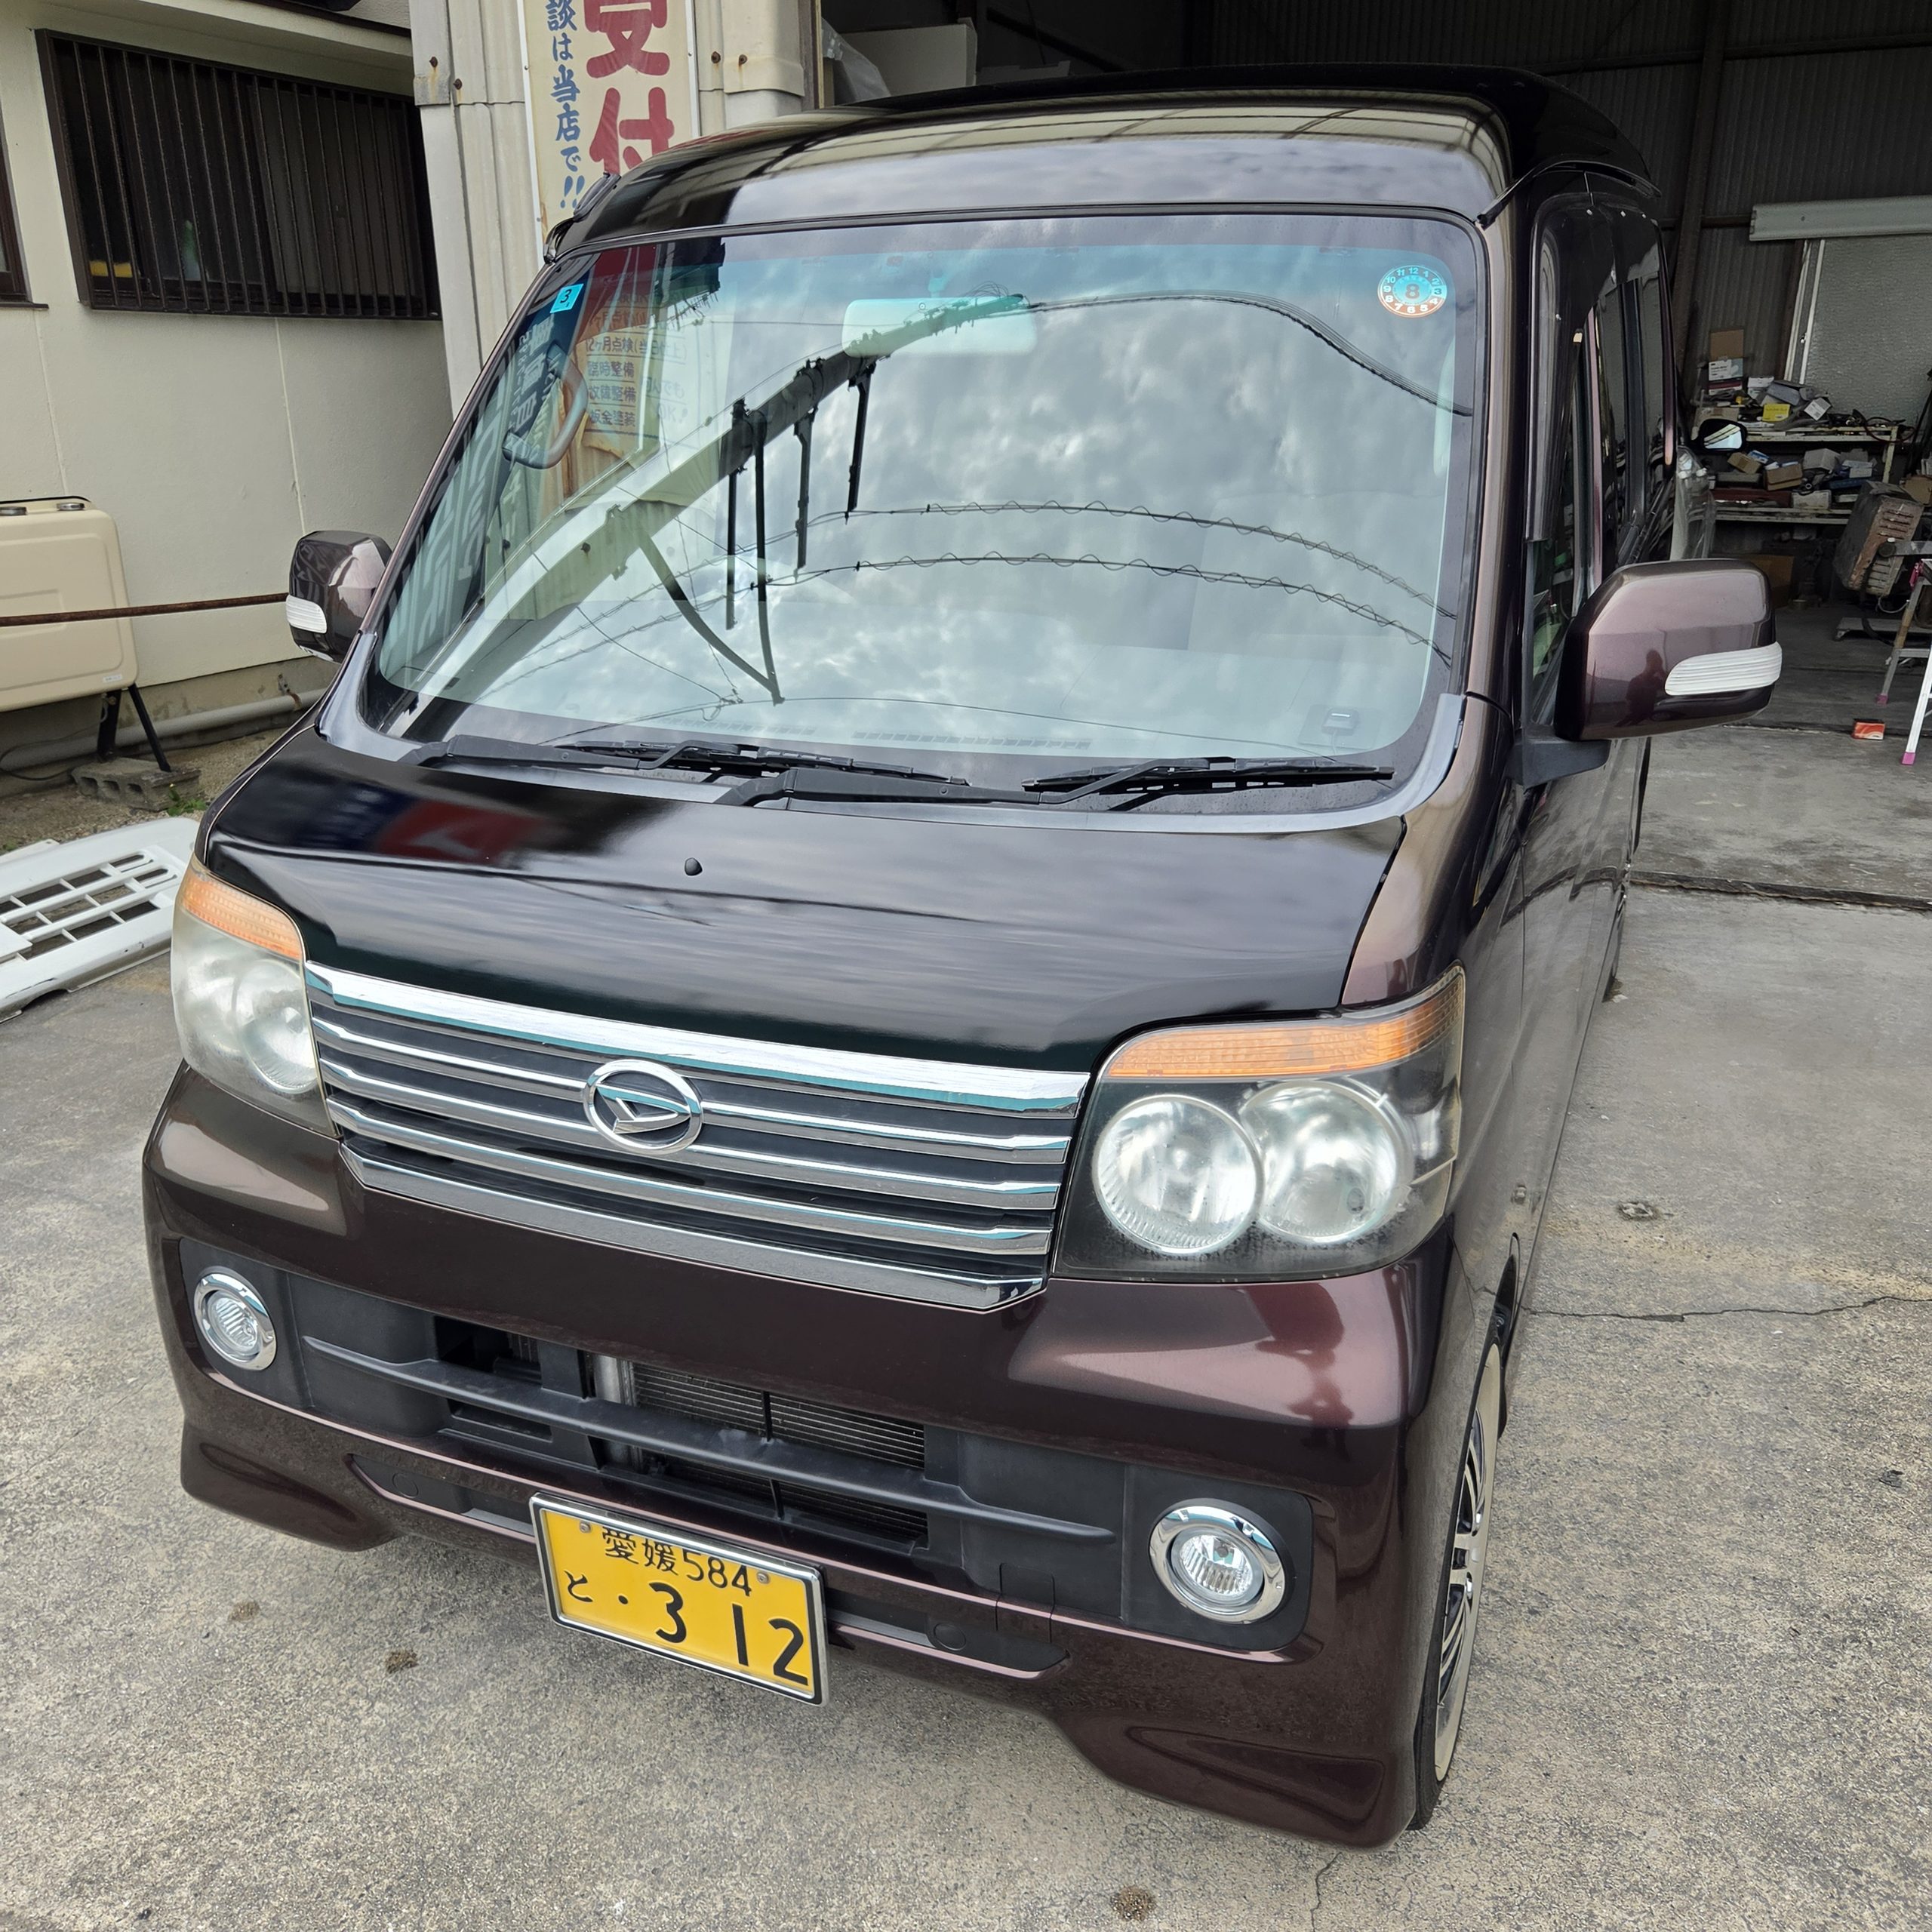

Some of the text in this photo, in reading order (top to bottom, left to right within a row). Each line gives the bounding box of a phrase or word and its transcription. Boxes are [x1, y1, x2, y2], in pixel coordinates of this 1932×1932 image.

[583, 0, 675, 174] 受付
[560, 289, 572, 303] 3
[1405, 283, 1420, 299] 8
[564, 1570, 593, 1602] と
